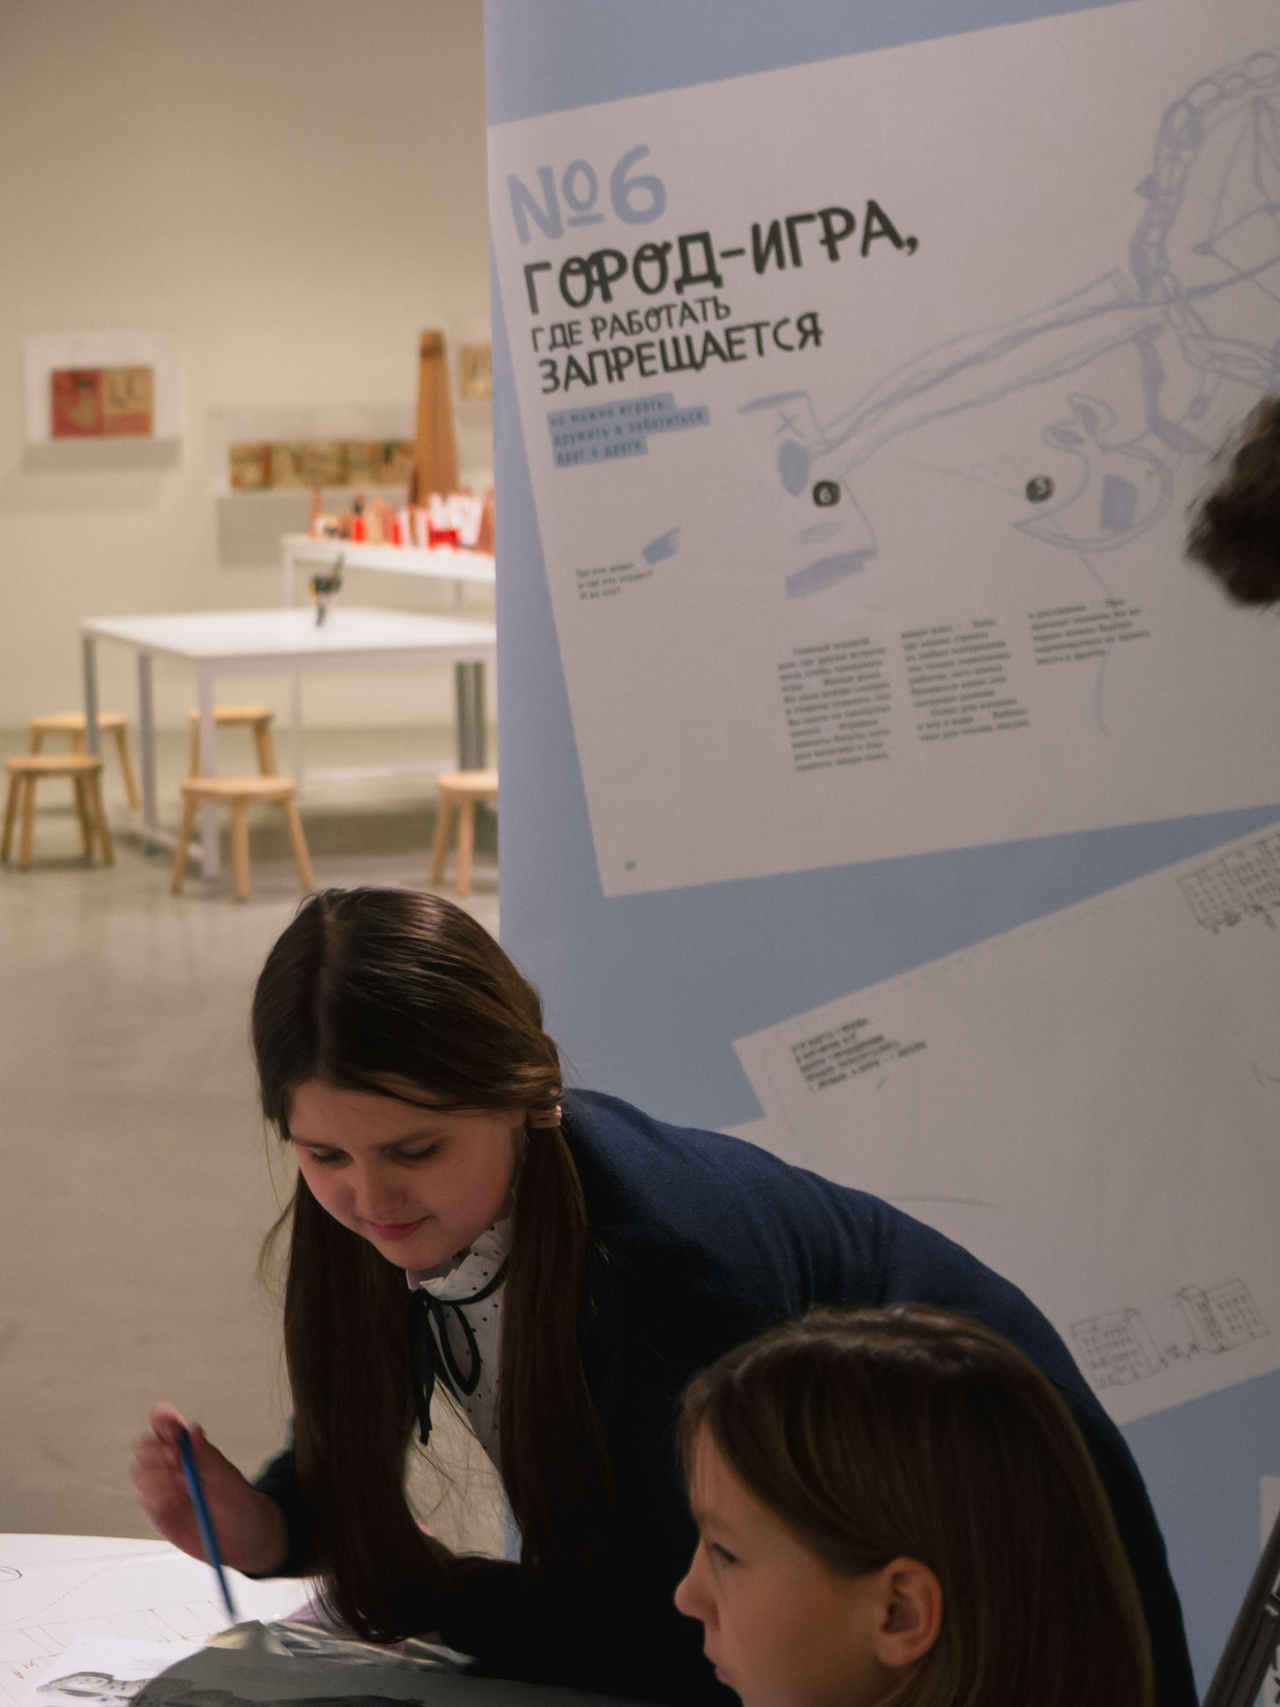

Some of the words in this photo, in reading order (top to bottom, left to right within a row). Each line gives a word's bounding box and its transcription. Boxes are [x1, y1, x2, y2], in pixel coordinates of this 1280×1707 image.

[523, 199, 919, 315] ГОРОД-ИГРА,
[531, 320, 583, 352] ГДЕ
[591, 296, 731, 342] РАБОТАТЬ
[538, 311, 825, 394] ЗАПРЕЩАЕТСЯ
